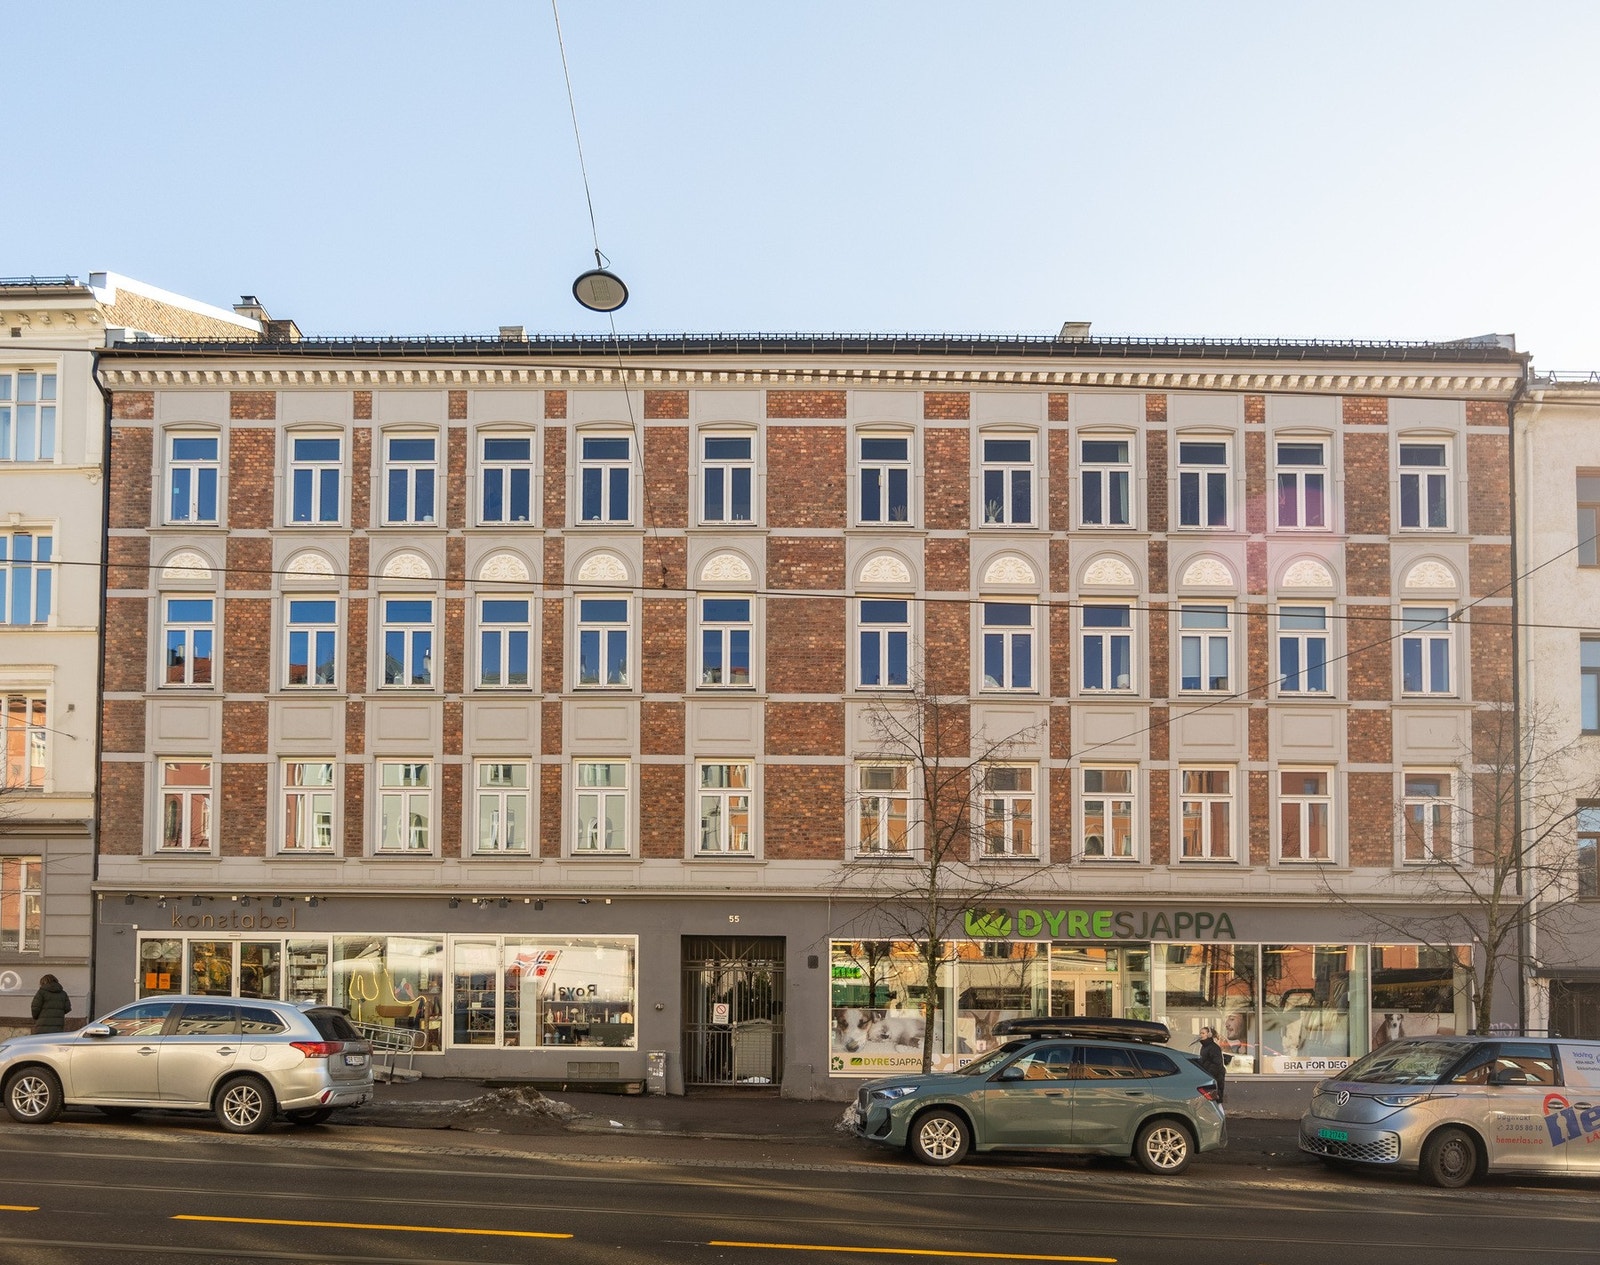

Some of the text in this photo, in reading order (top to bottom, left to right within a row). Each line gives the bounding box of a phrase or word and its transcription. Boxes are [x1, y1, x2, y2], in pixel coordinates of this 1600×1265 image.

[172, 905, 297, 929] konstabel
[728, 914, 741, 923] 55
[1017, 909, 1237, 940] DYRESJAPPA
[1283, 1060, 1348, 1070] BRA FOR DEG
